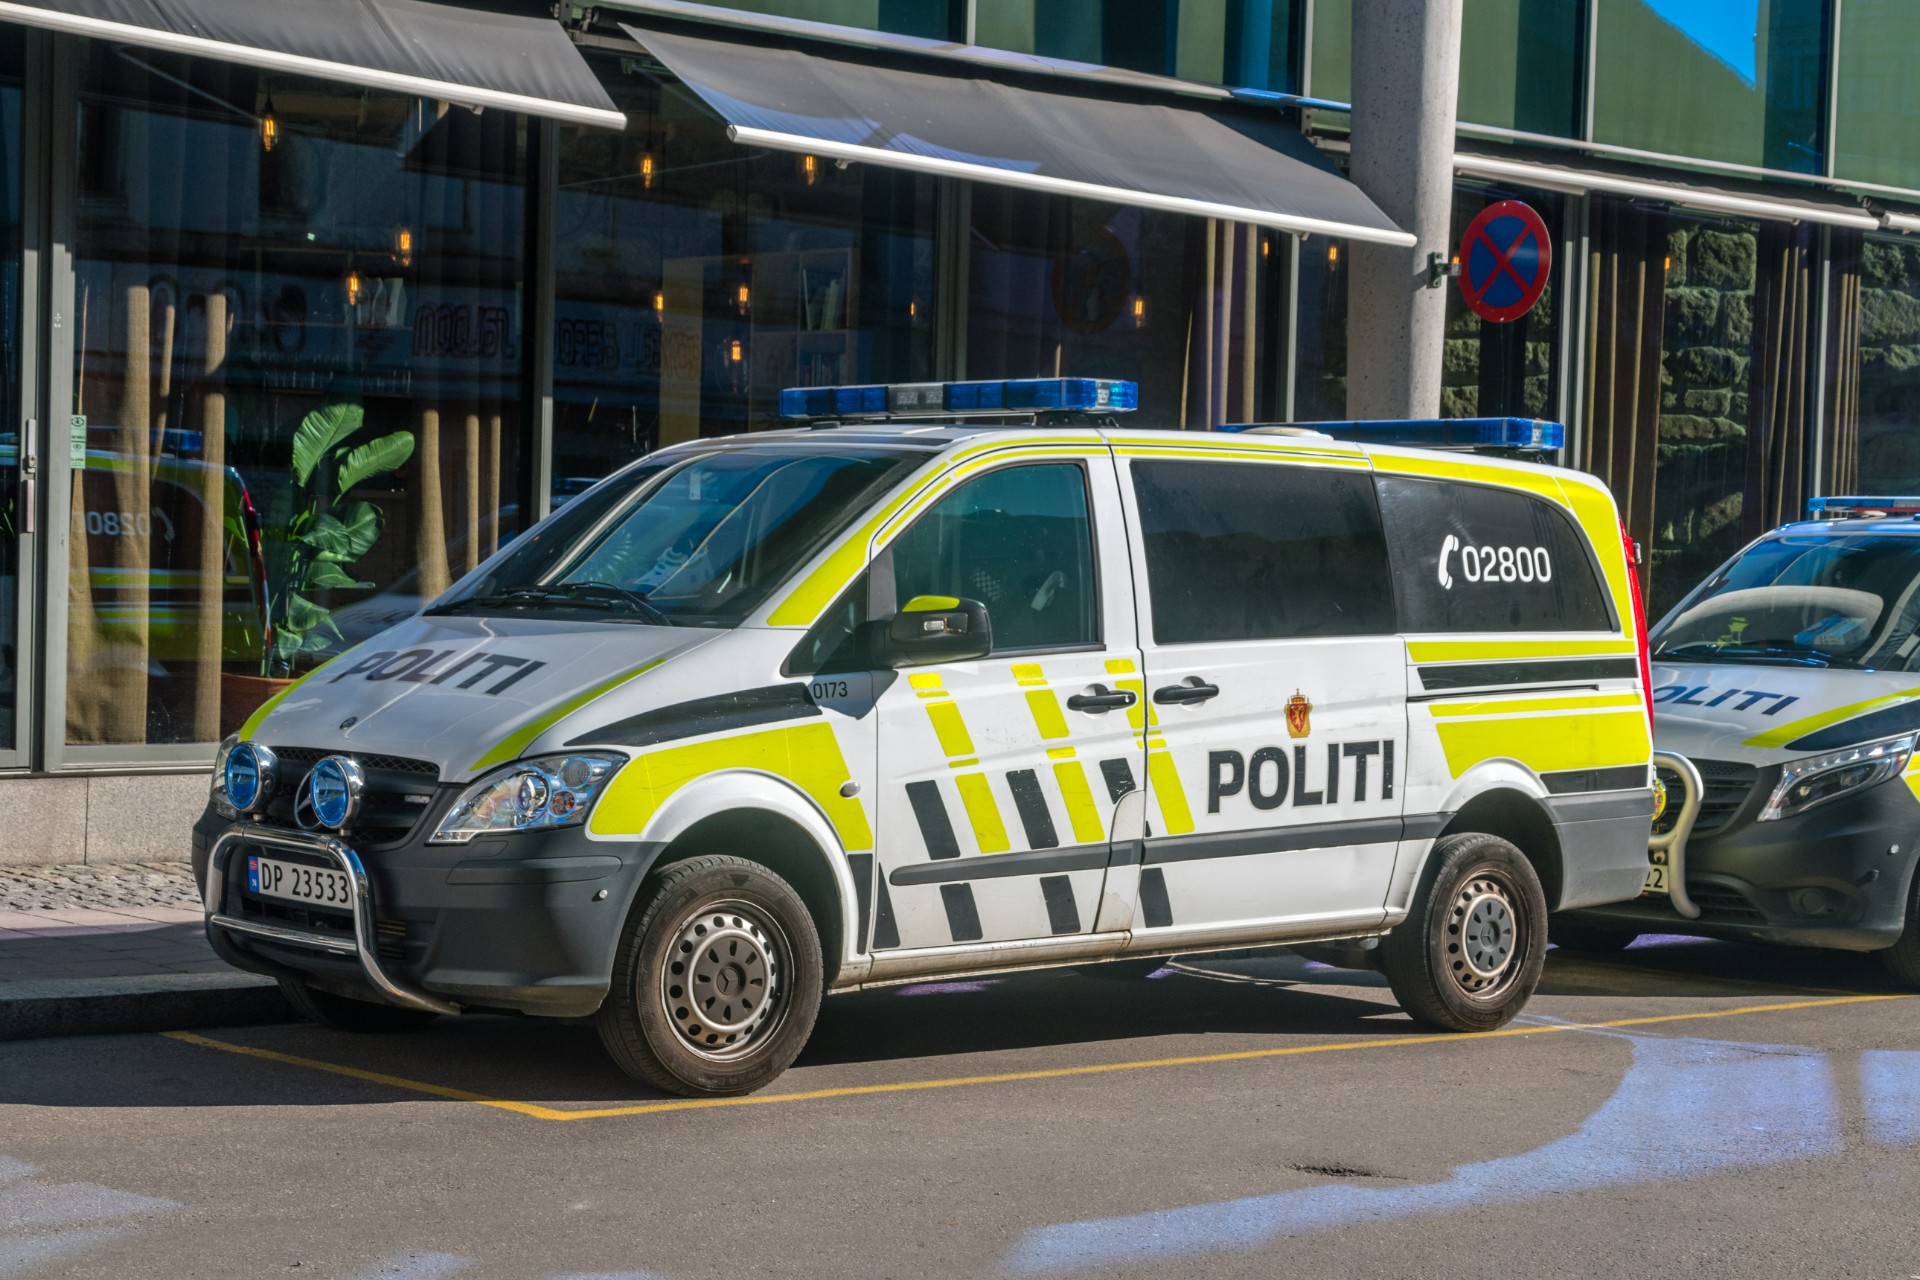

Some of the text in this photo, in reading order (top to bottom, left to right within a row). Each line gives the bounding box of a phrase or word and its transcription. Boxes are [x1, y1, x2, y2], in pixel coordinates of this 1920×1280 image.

[1462, 546, 1552, 582] 02800
[328, 648, 547, 696] POLITI
[813, 681, 848, 699] 0173
[1653, 685, 1800, 716] OLITI
[1207, 739, 1395, 814] POLITI
[261, 862, 349, 904] DP 23533
